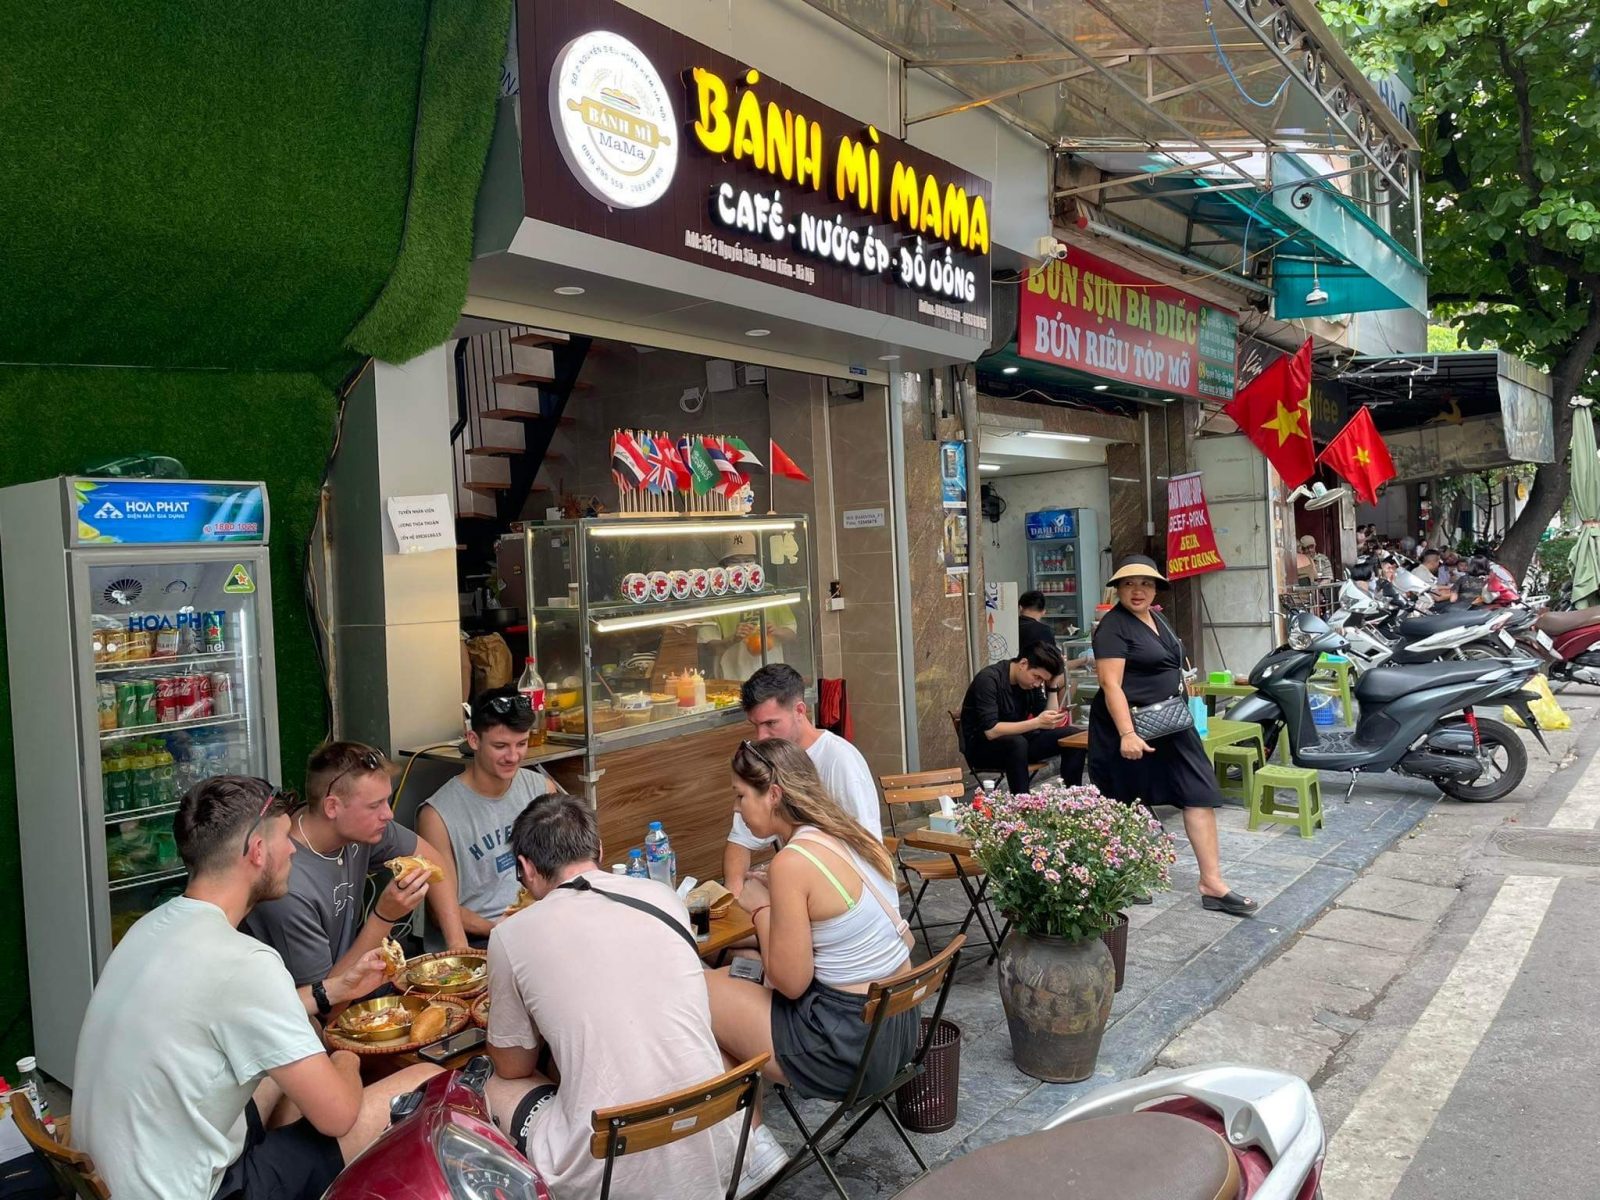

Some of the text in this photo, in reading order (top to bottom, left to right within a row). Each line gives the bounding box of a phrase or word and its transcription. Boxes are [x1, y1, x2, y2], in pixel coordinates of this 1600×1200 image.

[589, 107, 654, 142] BÁNH MÌ
[599, 132, 646, 161] MaMa
[693, 67, 988, 255] BÁNH MÌ MAMA
[717, 182, 785, 241] CAFÉ
[801, 211, 861, 267] NƯỚC
[863, 225, 890, 274] ÉP
[929, 246, 976, 302] UỐNG
[1083, 271, 1122, 324] SỤN
[1035, 311, 1080, 361] BÚN
[1085, 327, 1130, 374] RIÊU
[1133, 340, 1165, 382] TÓP
[1168, 550, 1220, 574] SOFT DRINK
